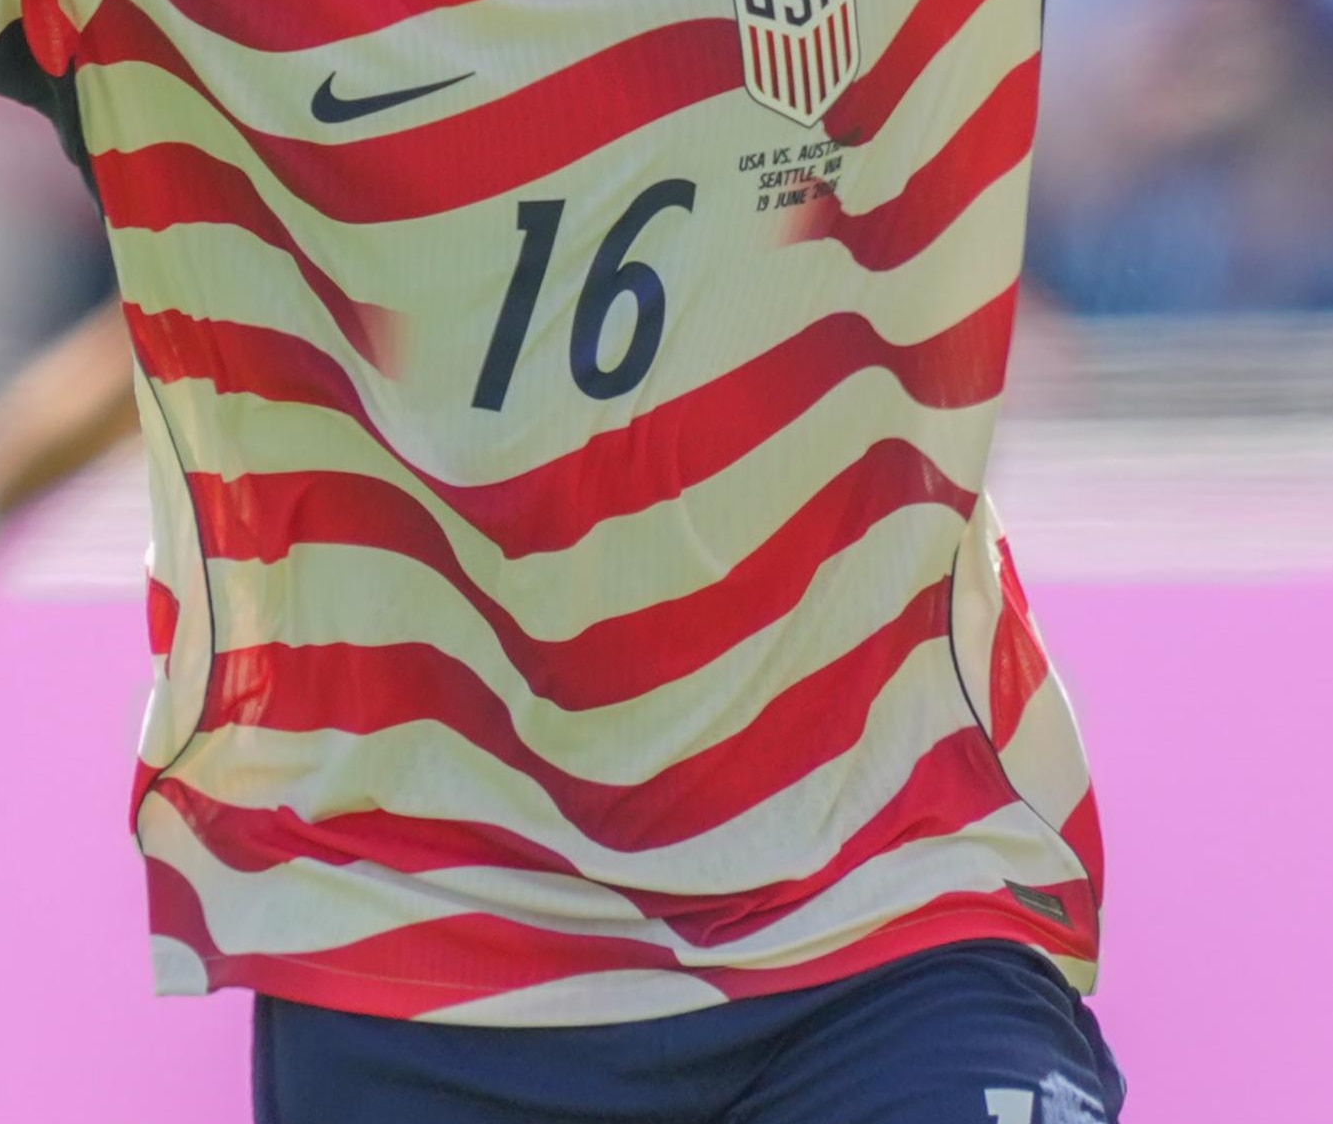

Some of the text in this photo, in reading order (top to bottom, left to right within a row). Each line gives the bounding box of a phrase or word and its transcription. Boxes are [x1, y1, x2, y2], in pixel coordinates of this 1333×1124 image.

[739, 152, 765, 172] USA
[756, 194, 770, 212] 19
[774, 187, 809, 209] JUNE
[471, 178, 697, 412] 16
